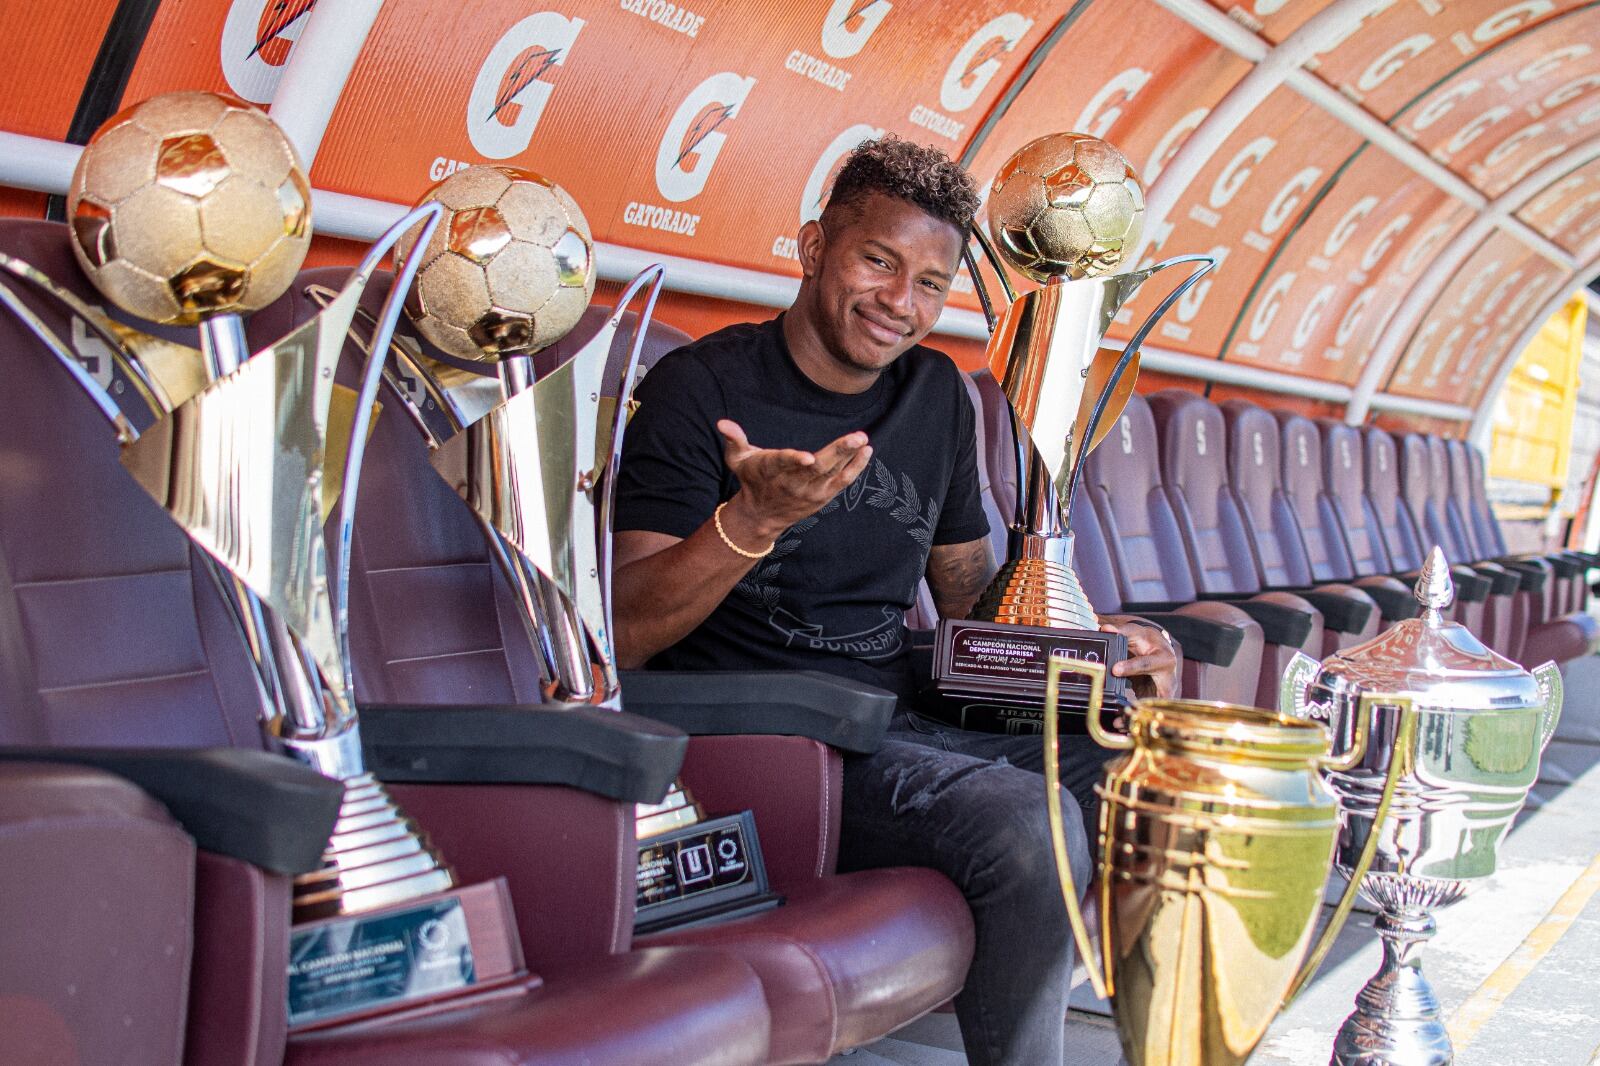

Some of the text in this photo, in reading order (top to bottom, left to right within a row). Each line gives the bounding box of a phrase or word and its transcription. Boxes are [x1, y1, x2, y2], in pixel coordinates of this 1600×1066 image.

[467, 11, 588, 159] G
[785, 50, 852, 91] GATORADE
[941, 12, 1034, 112] G
[1359, 33, 1435, 91] G
[655, 72, 757, 202] G
[910, 104, 966, 141] GATORADE
[1210, 136, 1277, 208] G
[1261, 166, 1322, 233] G
[624, 202, 701, 236] GATORADE
[1325, 196, 1379, 257] G
[1362, 213, 1411, 271] G
[1250, 272, 1297, 342] G
[1293, 285, 1336, 349] G
[1120, 414, 1132, 454] S
[1196, 419, 1206, 456] S
[809, 626, 898, 652] BUBERR
[969, 646, 1004, 655] DEPORTIVO
[1006, 643, 1041, 652] NACIONAL
